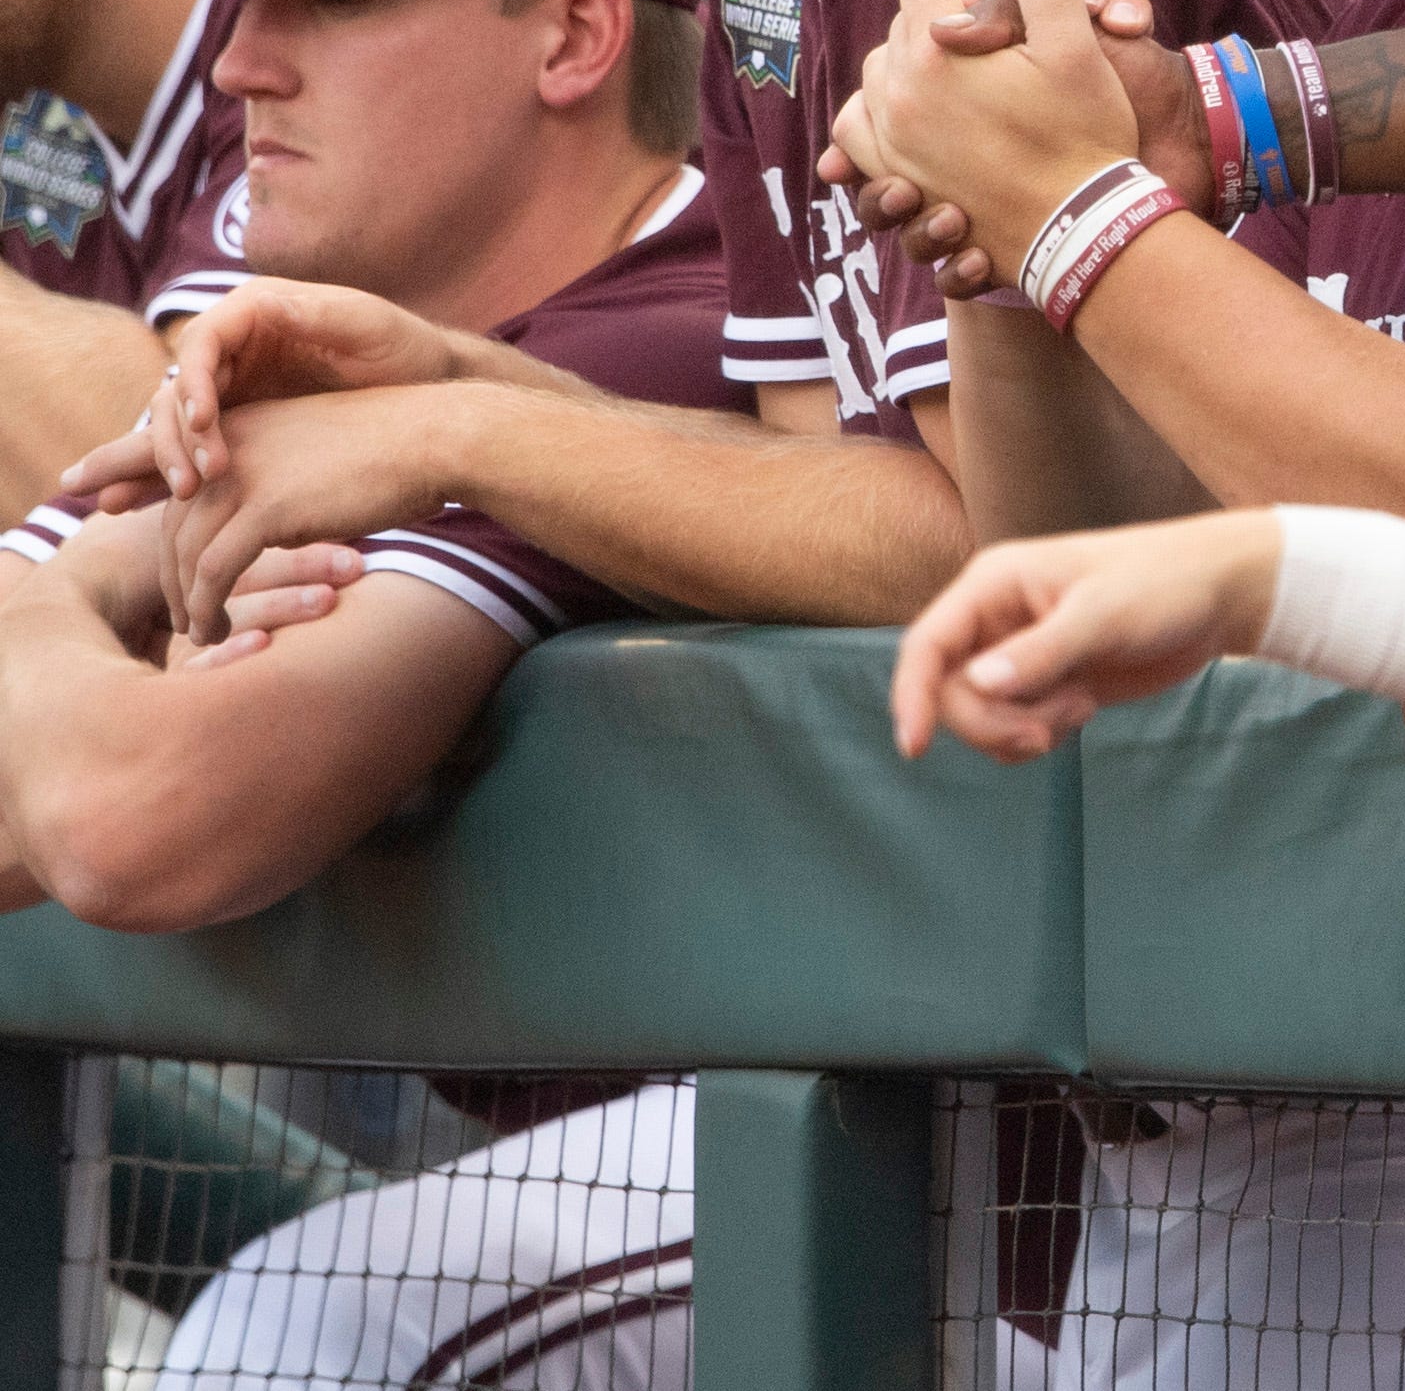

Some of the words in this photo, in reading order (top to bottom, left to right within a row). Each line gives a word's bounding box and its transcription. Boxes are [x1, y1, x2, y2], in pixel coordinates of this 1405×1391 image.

[1302, 65, 1325, 102] Team
[1058, 273, 1083, 303] Right
[1075, 246, 1104, 279] Here!
[1099, 218, 1130, 252] Right
[1126, 195, 1160, 226] Now!
